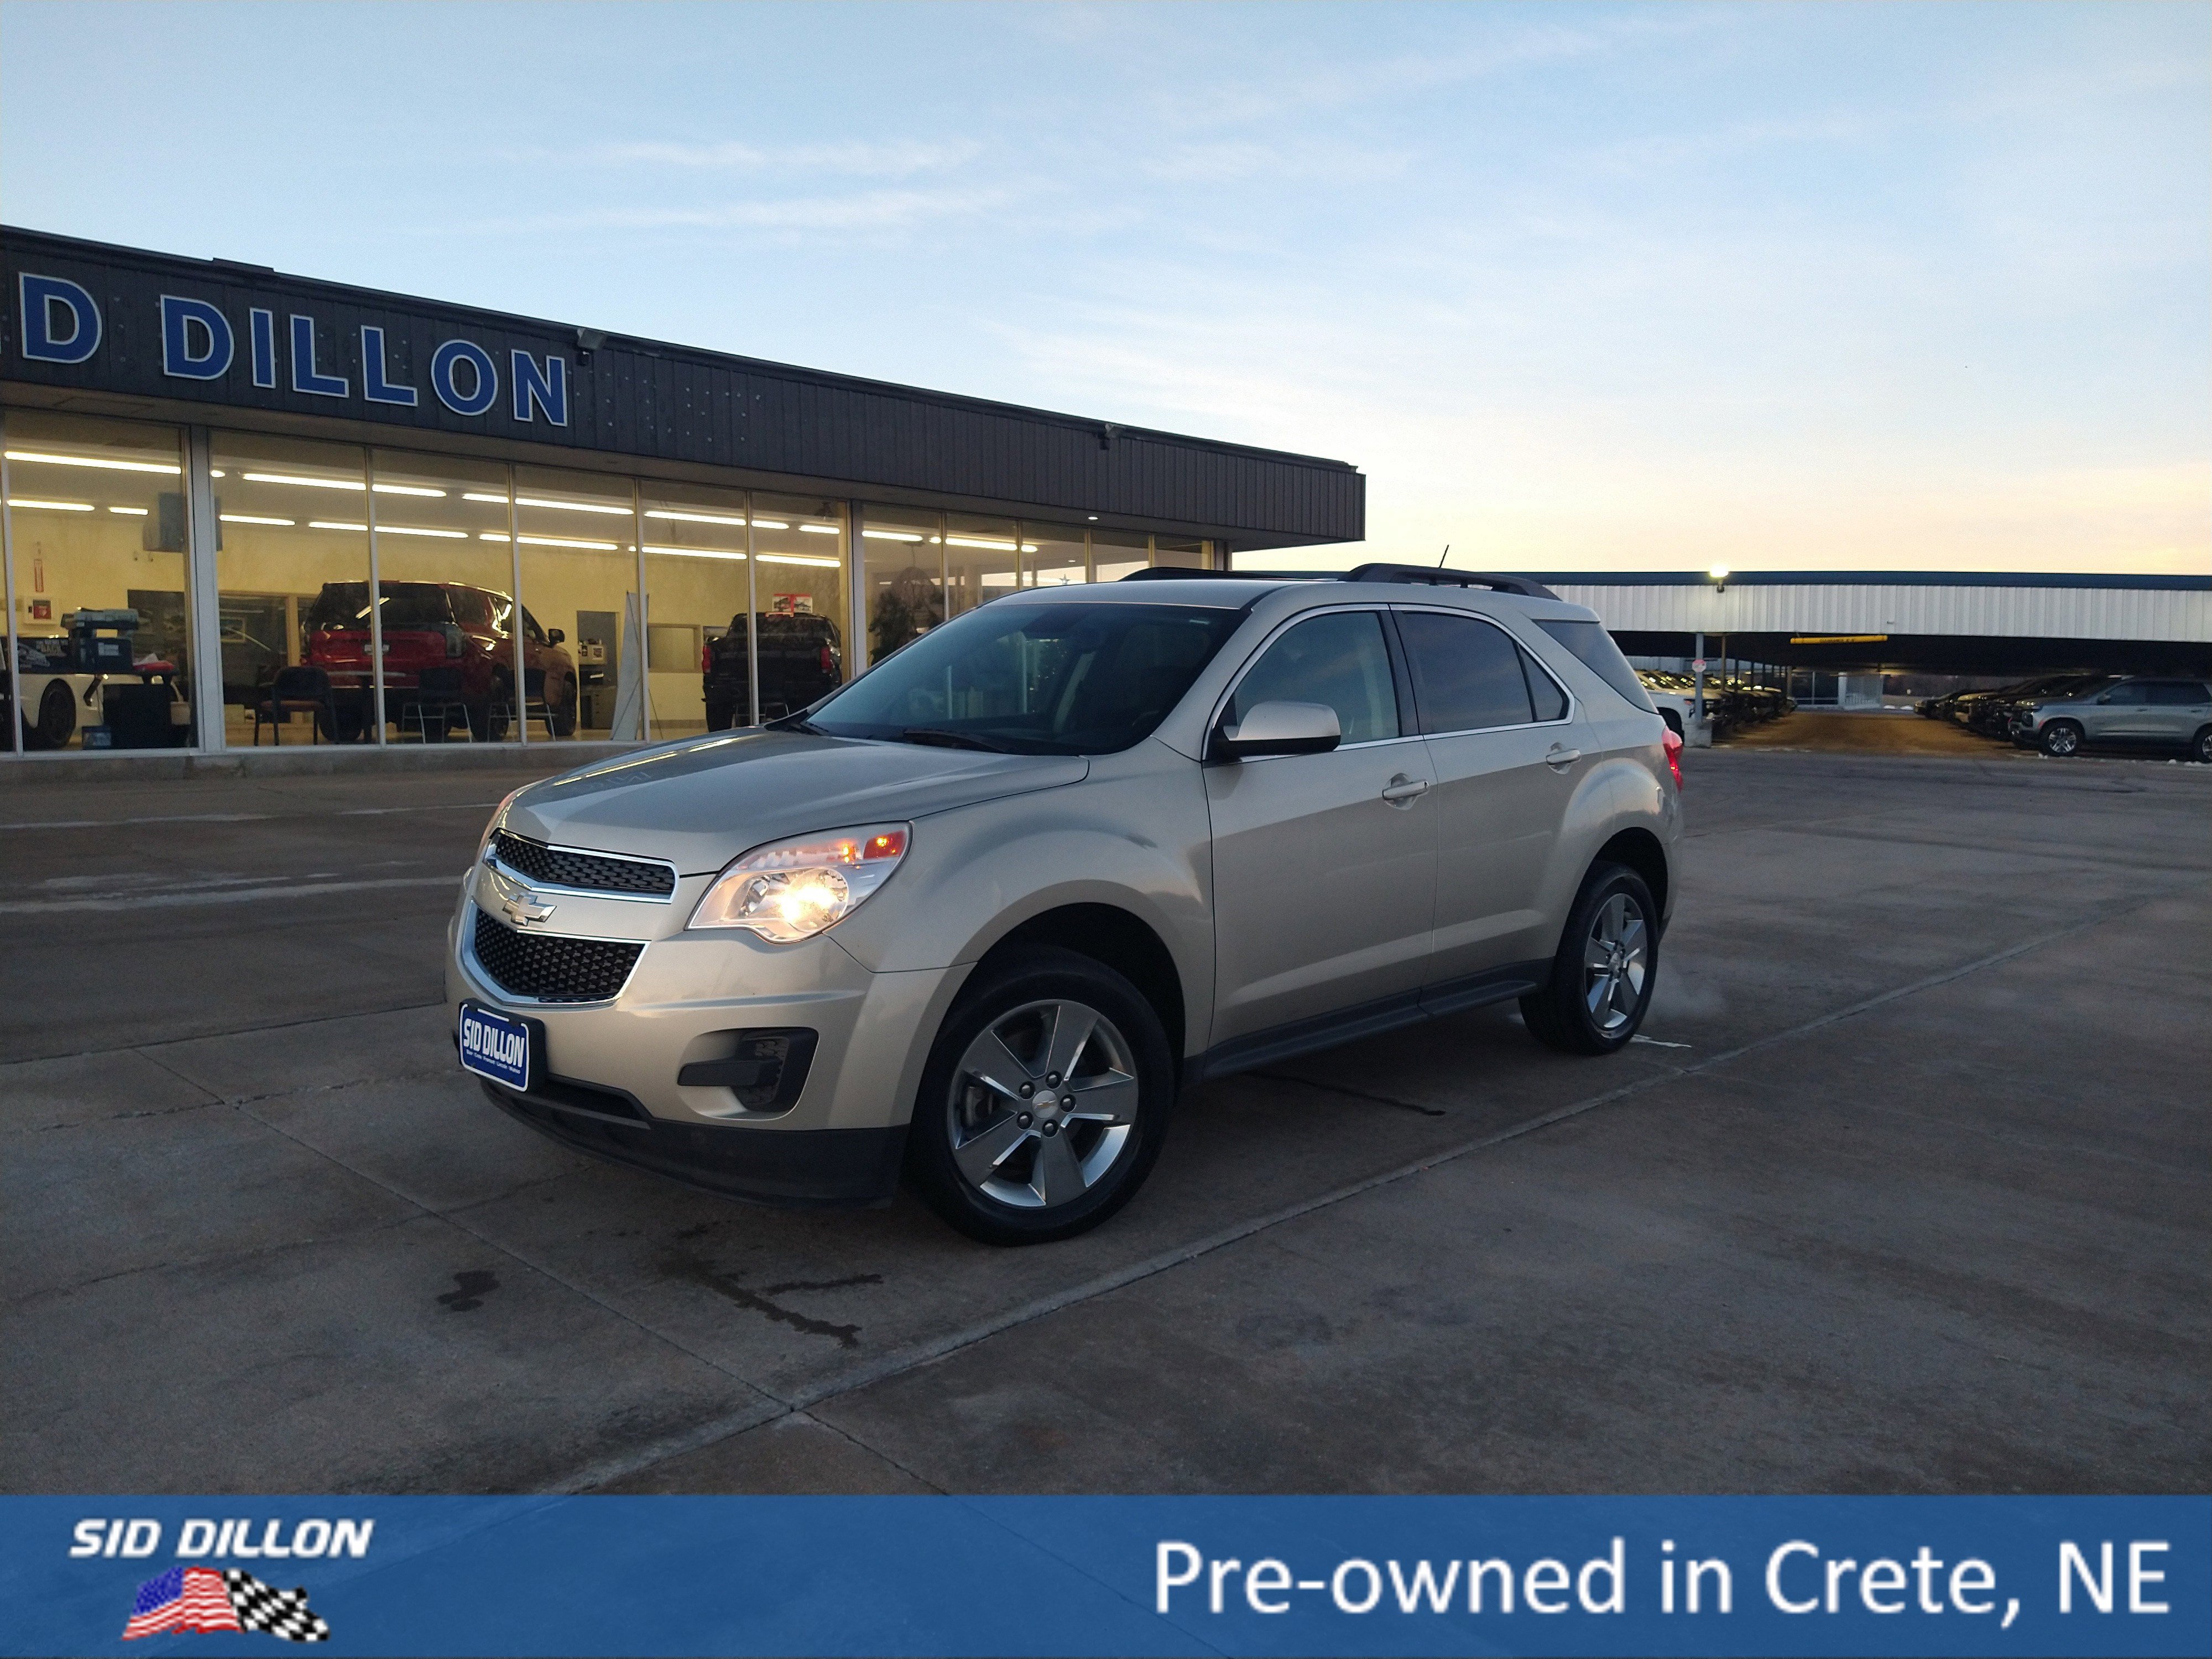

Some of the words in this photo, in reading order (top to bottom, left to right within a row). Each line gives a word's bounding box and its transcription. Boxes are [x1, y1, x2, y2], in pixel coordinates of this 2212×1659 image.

[160, 294, 568, 427] DILLON
[463, 1018, 482, 1052] SID
[482, 1025, 525, 1068] DILLON
